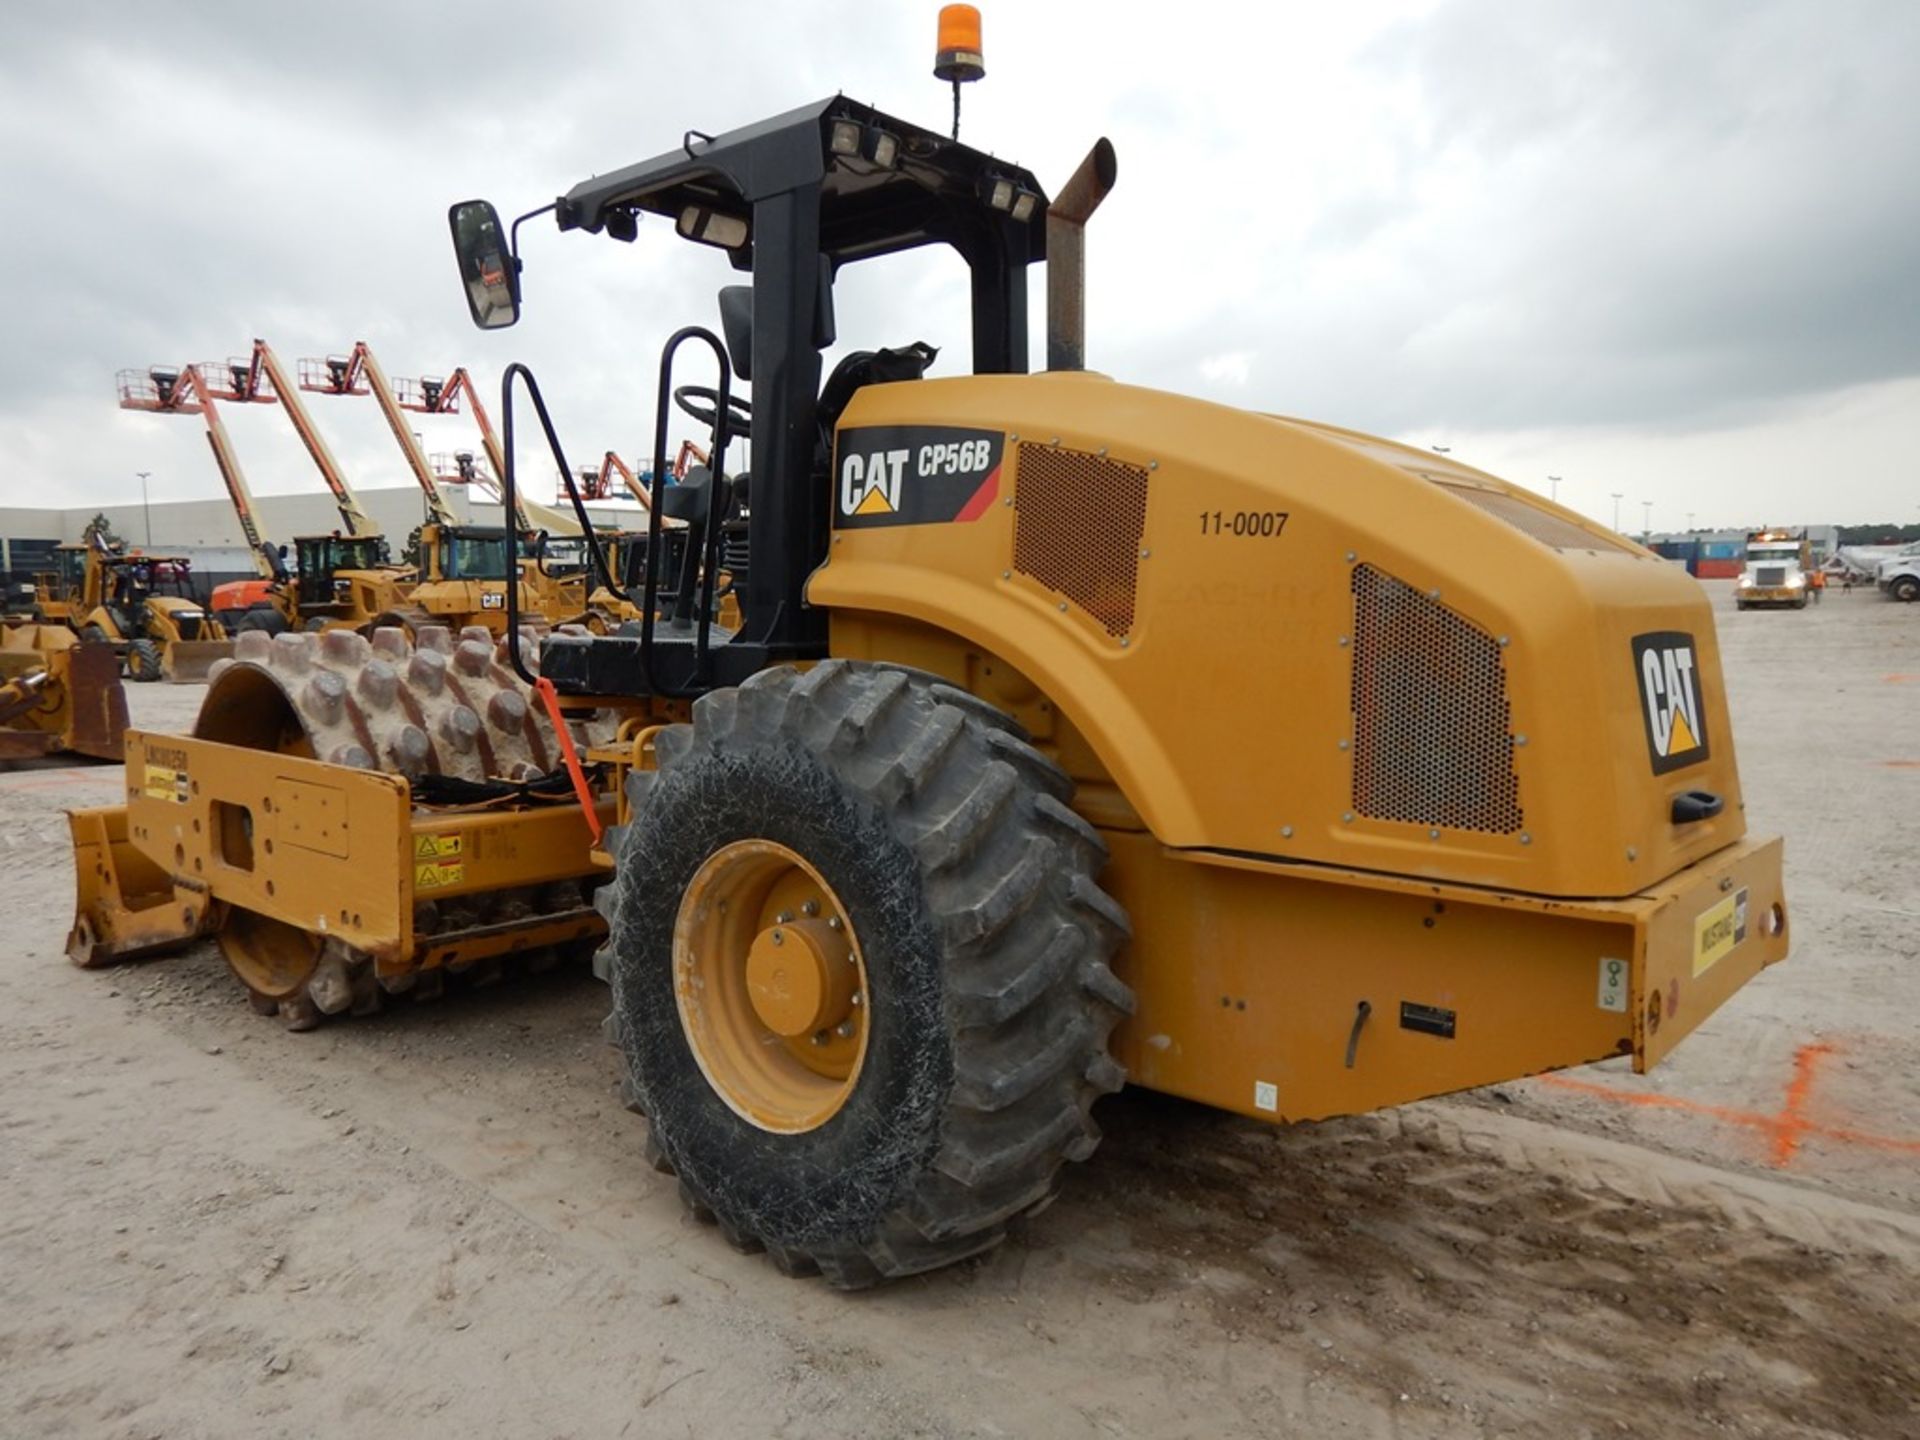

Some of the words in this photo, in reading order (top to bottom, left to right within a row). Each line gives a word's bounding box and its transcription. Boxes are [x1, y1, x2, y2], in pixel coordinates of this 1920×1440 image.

[841, 449, 909, 516] CAT
[918, 439, 991, 477] CP56B
[1200, 511, 1289, 537] 11-0007
[482, 596, 502, 608] CAT
[1642, 647, 1701, 757] CAT
